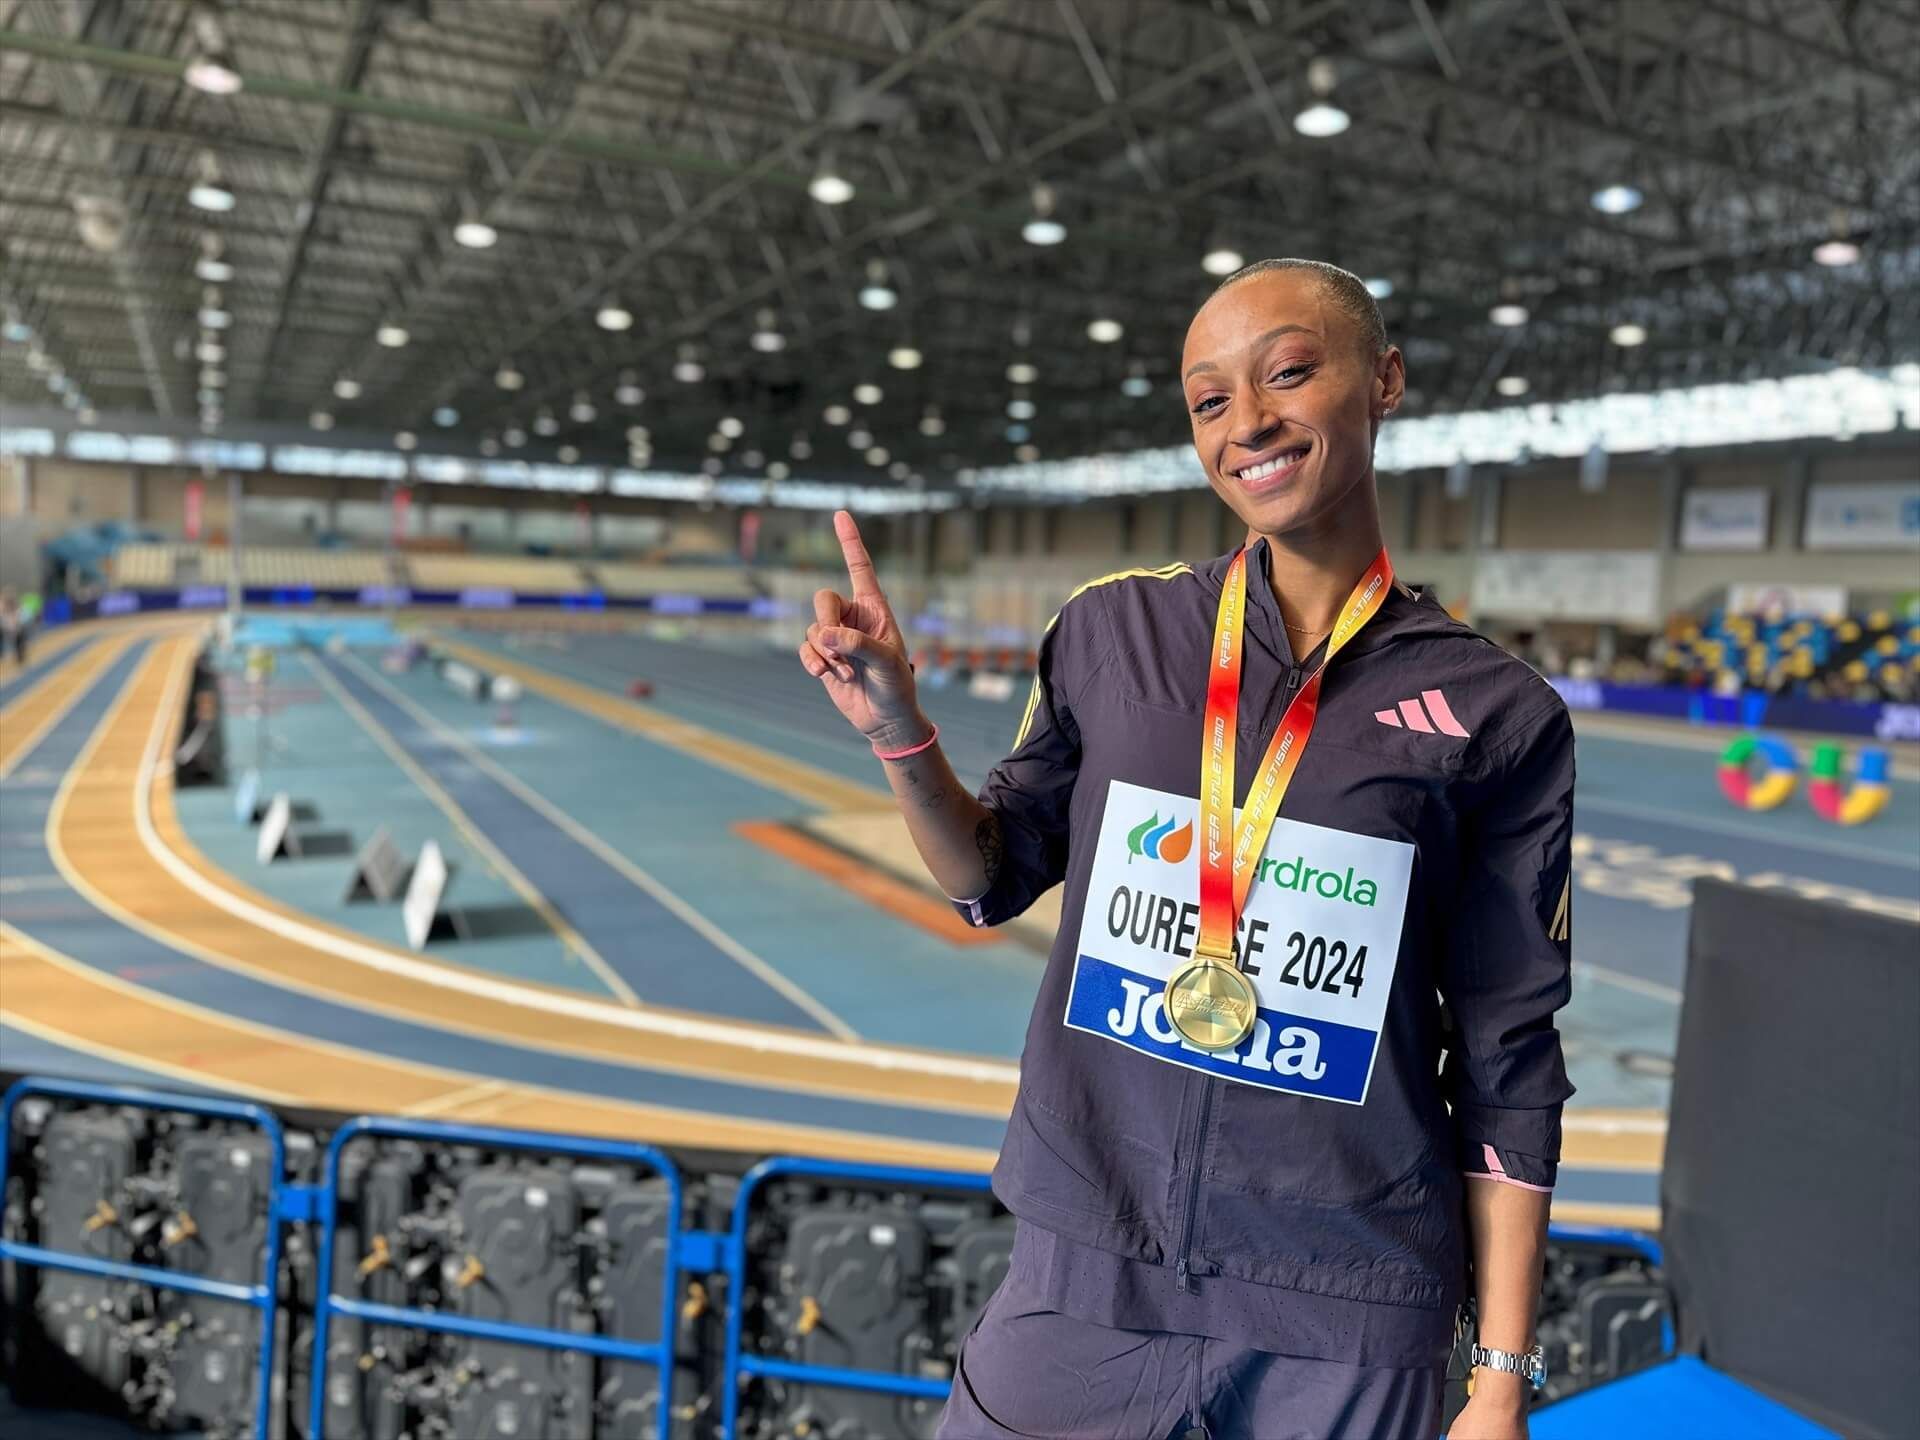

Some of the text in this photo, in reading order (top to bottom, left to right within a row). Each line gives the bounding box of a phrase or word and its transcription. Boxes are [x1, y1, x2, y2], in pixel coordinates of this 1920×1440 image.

[1219, 630, 1232, 669] RFEA
[1208, 716, 1225, 869] RFEA ATLETISMO
[1233, 730, 1294, 877] RFEA ATLETISMO
[1252, 856, 1379, 907] rdrola
[1107, 885, 1369, 999] OUREE 2024
